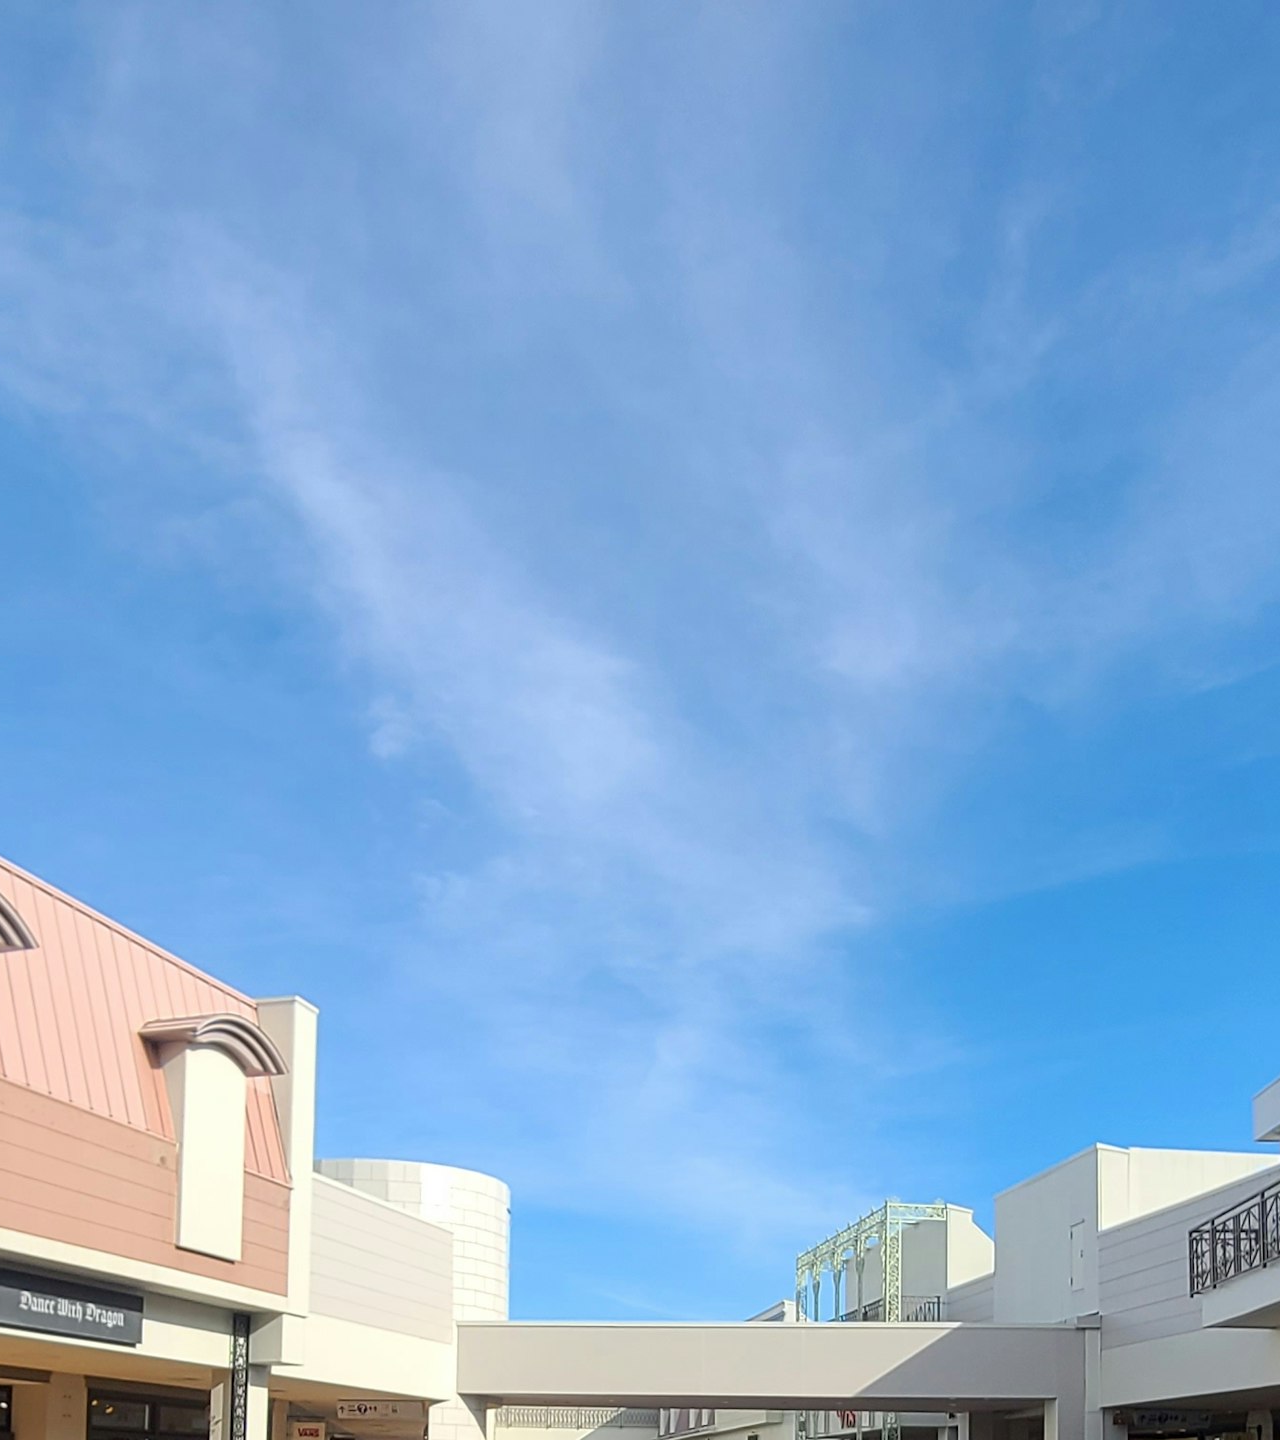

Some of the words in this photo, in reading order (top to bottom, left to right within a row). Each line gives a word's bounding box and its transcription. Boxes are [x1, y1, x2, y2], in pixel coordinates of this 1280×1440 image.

[19, 1290, 55, 1315] Dance
[57, 1297, 82, 1323] With
[84, 1302, 124, 1328] Dragon
[297, 1427, 319, 1437] VANS
